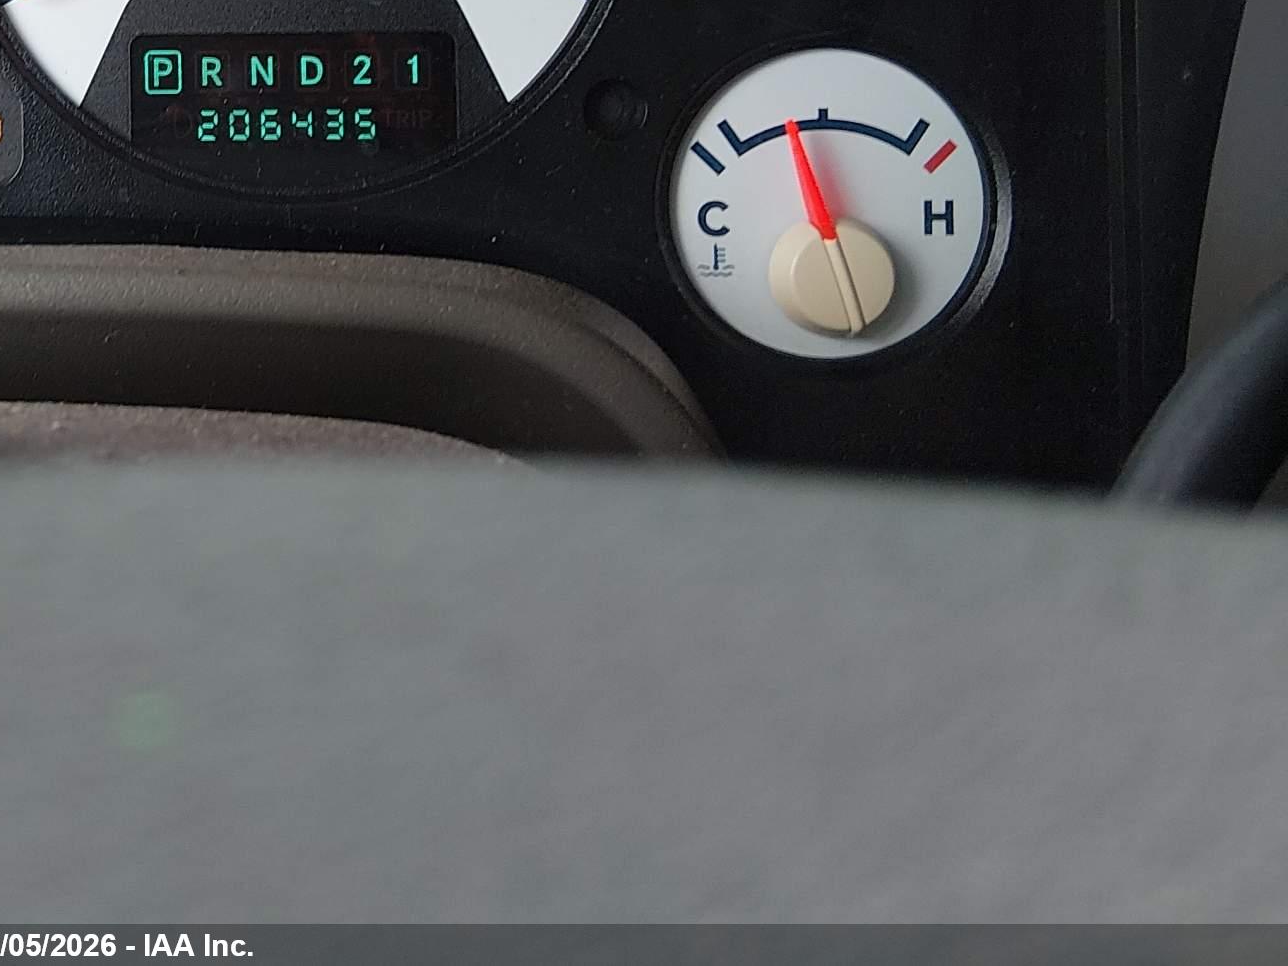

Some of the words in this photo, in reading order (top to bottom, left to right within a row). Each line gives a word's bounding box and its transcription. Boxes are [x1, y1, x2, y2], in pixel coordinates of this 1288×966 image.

[153, 57, 173, 87] P
[202, 57, 222, 86] R
[251, 56, 273, 85] N
[301, 56, 323, 85] D
[354, 55, 371, 84] 2
[408, 55, 417, 83] 1
[198, 109, 375, 141] 206435
[698, 201, 730, 236] C
[924, 200, 954, 235] H
